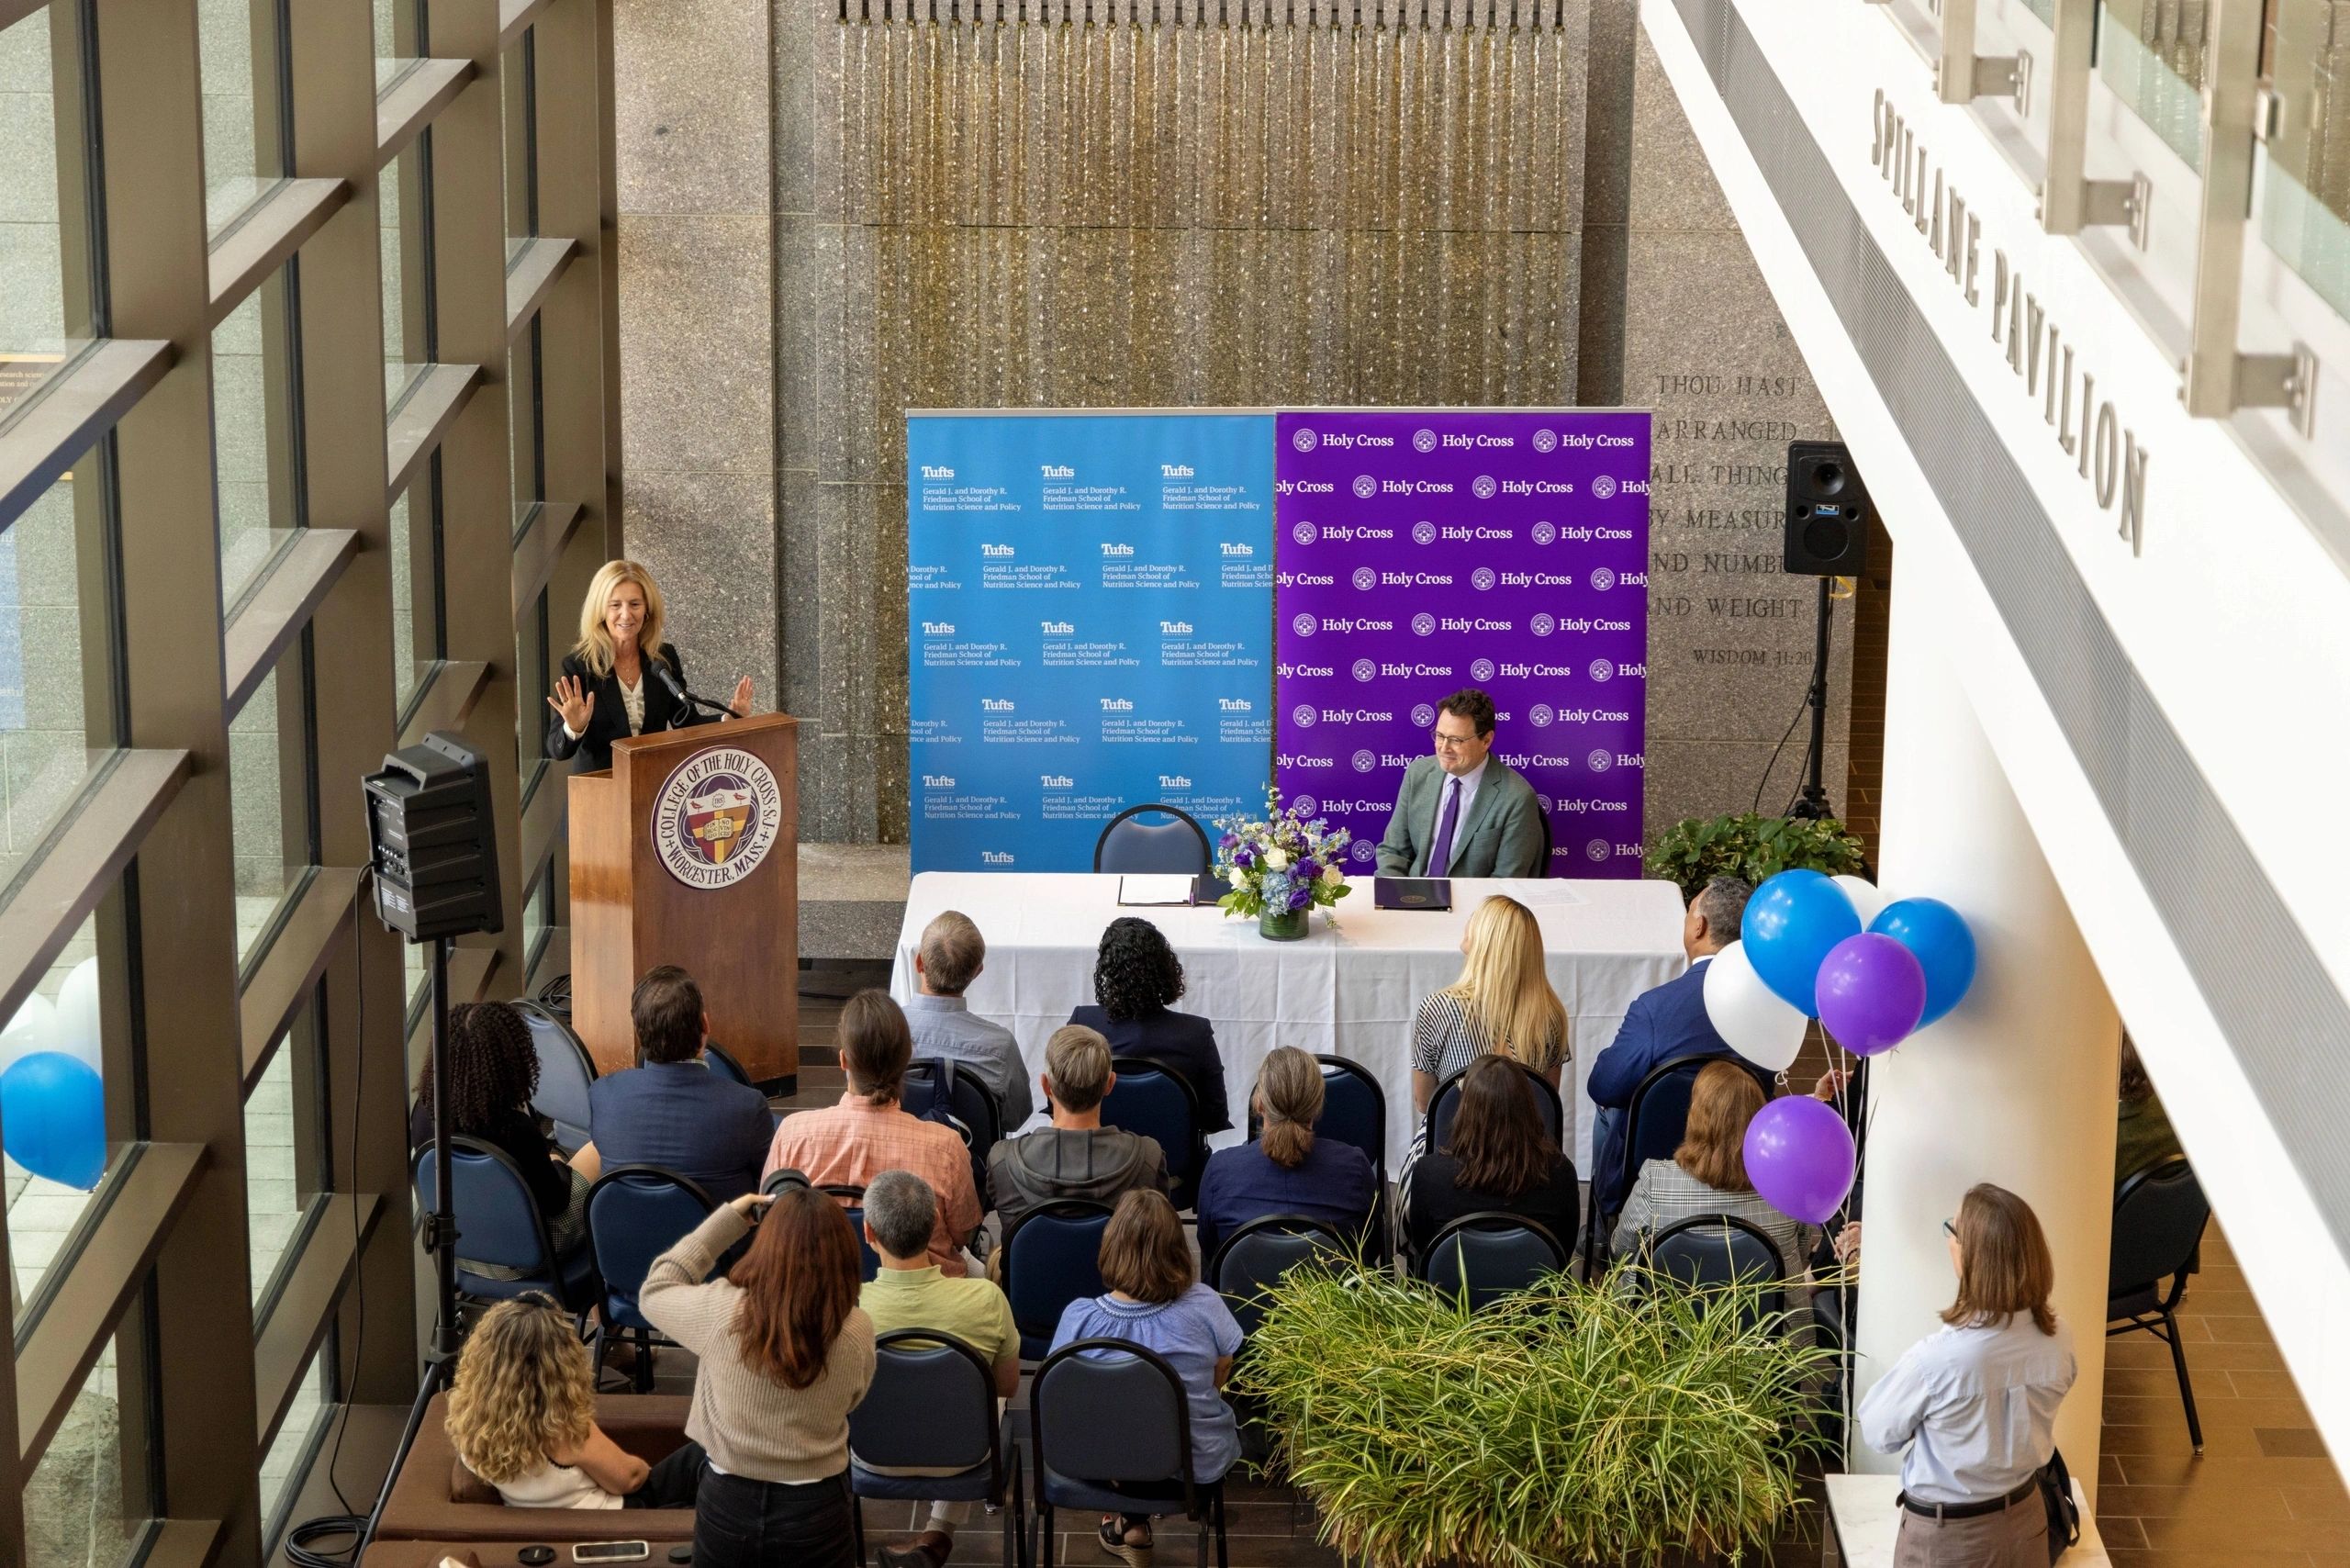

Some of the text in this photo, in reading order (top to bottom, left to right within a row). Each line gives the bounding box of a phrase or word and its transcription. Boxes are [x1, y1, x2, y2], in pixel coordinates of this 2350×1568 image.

[1872, 87, 2150, 559] SPILLANE PAVILION
[1656, 375, 1801, 397] THOU HAST
[1656, 420, 1797, 441] ARRANGED
[1323, 434, 1393, 449] Holy Cross
[1443, 434, 1514, 449] Holy Cross
[1563, 434, 1633, 449] Holy Cross
[922, 465, 955, 477] Tufts
[1042, 465, 1075, 477] Tufts
[1161, 465, 1194, 476] Tufts
[1651, 465, 1789, 486] ALL THING
[923, 487, 946, 495] Gerald
[954, 487, 968, 495] and
[969, 487, 998, 497] Dorothy
[1162, 486, 1186, 494] Gerald
[1193, 486, 1208, 494] and
[1209, 486, 1237, 496] Dorothy
[1276, 480, 1333, 495] oly Cross
[1383, 480, 1453, 495] Holy Cross
[1503, 481, 1572, 496] Holy Cross
[923, 495, 991, 503] Friedman School of
[1162, 494, 1231, 502] Friedman School of
[1000, 503, 1021, 512] Policy
[1239, 502, 1260, 511] Policy
[1685, 510, 1785, 530] MEASUR
[1323, 526, 1393, 541] Holy Cross
[1442, 527, 1512, 542] Holy Cross
[1561, 527, 1632, 542] Holy Cross
[982, 543, 1015, 555] Tufts
[1102, 543, 1135, 555] Tufts
[1221, 543, 1254, 554] Tufts
[1102, 565, 1125, 573] Gerald
[1133, 565, 1147, 573] and
[1148, 565, 1177, 575] Dorothy
[1653, 554, 1785, 574] ND NUMB
[1102, 573, 1170, 581] Friedman School of
[1277, 572, 1333, 588] oly Cross
[1382, 572, 1452, 587] Holy Cross
[1501, 573, 1572, 588] Holy Cross
[1179, 581, 1200, 590] Policy
[1648, 597, 1803, 618] ND WEIGHT
[923, 622, 956, 633] Tufts
[1042, 622, 1075, 633] Tufts
[1160, 622, 1193, 633] Tufts
[1323, 619, 1393, 633] Holy Cross
[1441, 618, 1511, 633] Holy Cross
[1561, 619, 1630, 633] Holy Cross
[923, 643, 947, 651] Gerald
[955, 643, 969, 651] and
[970, 643, 999, 653] Dorothy
[923, 651, 992, 659] Friedman School of
[1001, 659, 1022, 668] Policy
[1693, 649, 1766, 665] WISDOM
[1277, 664, 1333, 678] oly Cross
[1382, 664, 1451, 678] Holy Cross
[1500, 664, 1570, 678] Holy Cross
[982, 699, 1015, 711] Tufts
[1101, 699, 1134, 711] Tufts
[1219, 699, 1252, 711] Tufts
[1323, 710, 1392, 724] Holy Cross
[1559, 710, 1628, 723] Holy Cross
[1277, 754, 1333, 768] oly Cross
[1382, 755, 1411, 768] Holy
[1500, 755, 1569, 768] Holy Cross
[923, 776, 957, 788] Tufts
[1041, 776, 1074, 788] Tufts
[1159, 776, 1192, 788] Tufts
[660, 778, 689, 839] COLLEGE
[686, 765, 701, 782] OF
[700, 753, 722, 774] THE
[724, 753, 755, 775] HOLY
[751, 767, 778, 806] CROSS
[1322, 800, 1392, 814] Holy Cross
[1558, 799, 1628, 813] Holy Cross
[733, 841, 767, 878] MASS.
[982, 852, 1015, 864] Tufts
